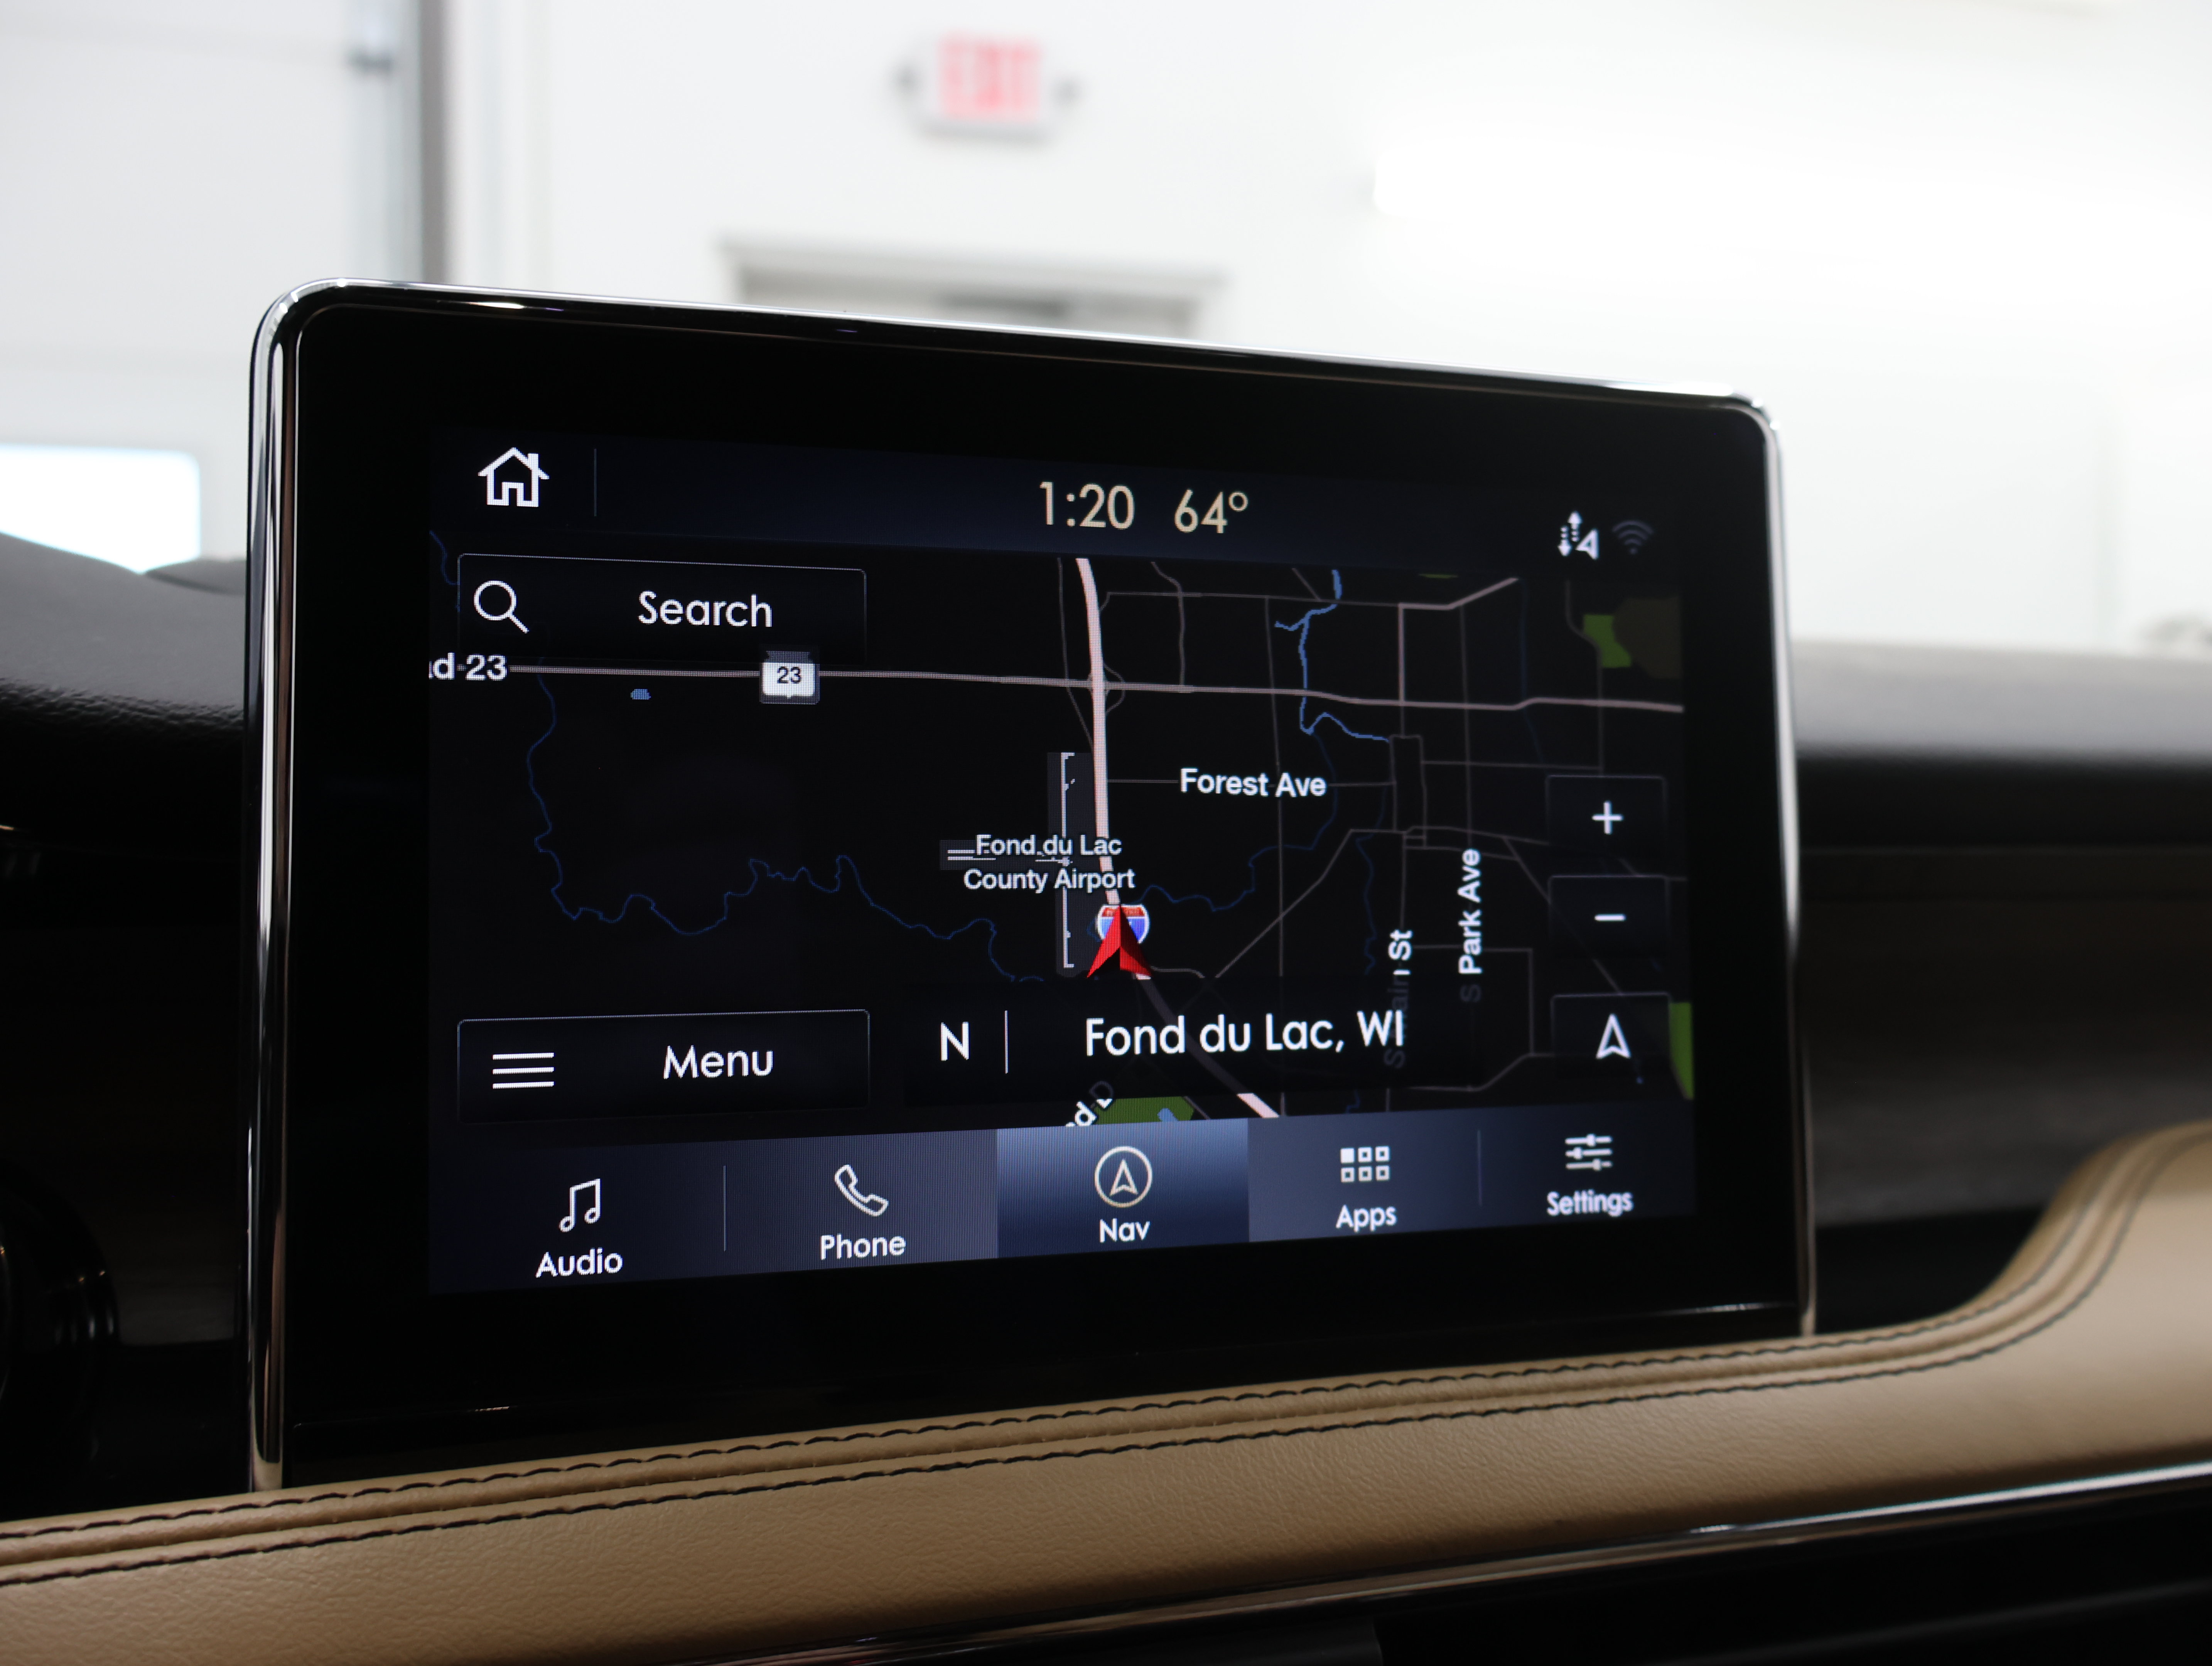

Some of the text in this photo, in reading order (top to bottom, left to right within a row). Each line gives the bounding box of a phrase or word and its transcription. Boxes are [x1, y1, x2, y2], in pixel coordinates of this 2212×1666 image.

[1039, 481, 1135, 530] 1:20
[638, 590, 773, 628] Search
[465, 654, 508, 681] 23
[777, 665, 801, 685] 23
[1180, 767, 1327, 798] Forest Ave
[975, 833, 1122, 856] Fond du Lac
[963, 867, 1136, 894] County Airport
[1457, 848, 1482, 904] Ave
[1387, 929, 1413, 961] St
[1458, 909, 1483, 975] Park
[940, 1021, 969, 1061] N
[1086, 1009, 1404, 1057] Fond du Lac, WI
[663, 1045, 774, 1080] Menu
[1065, 1100, 1098, 1127] d
[1547, 1189, 1633, 1216] Settings
[1099, 1218, 1151, 1243] Nav
[1335, 1204, 1397, 1233] Apps
[535, 1247, 623, 1278] Audio
[820, 1234, 906, 1260] Phone
